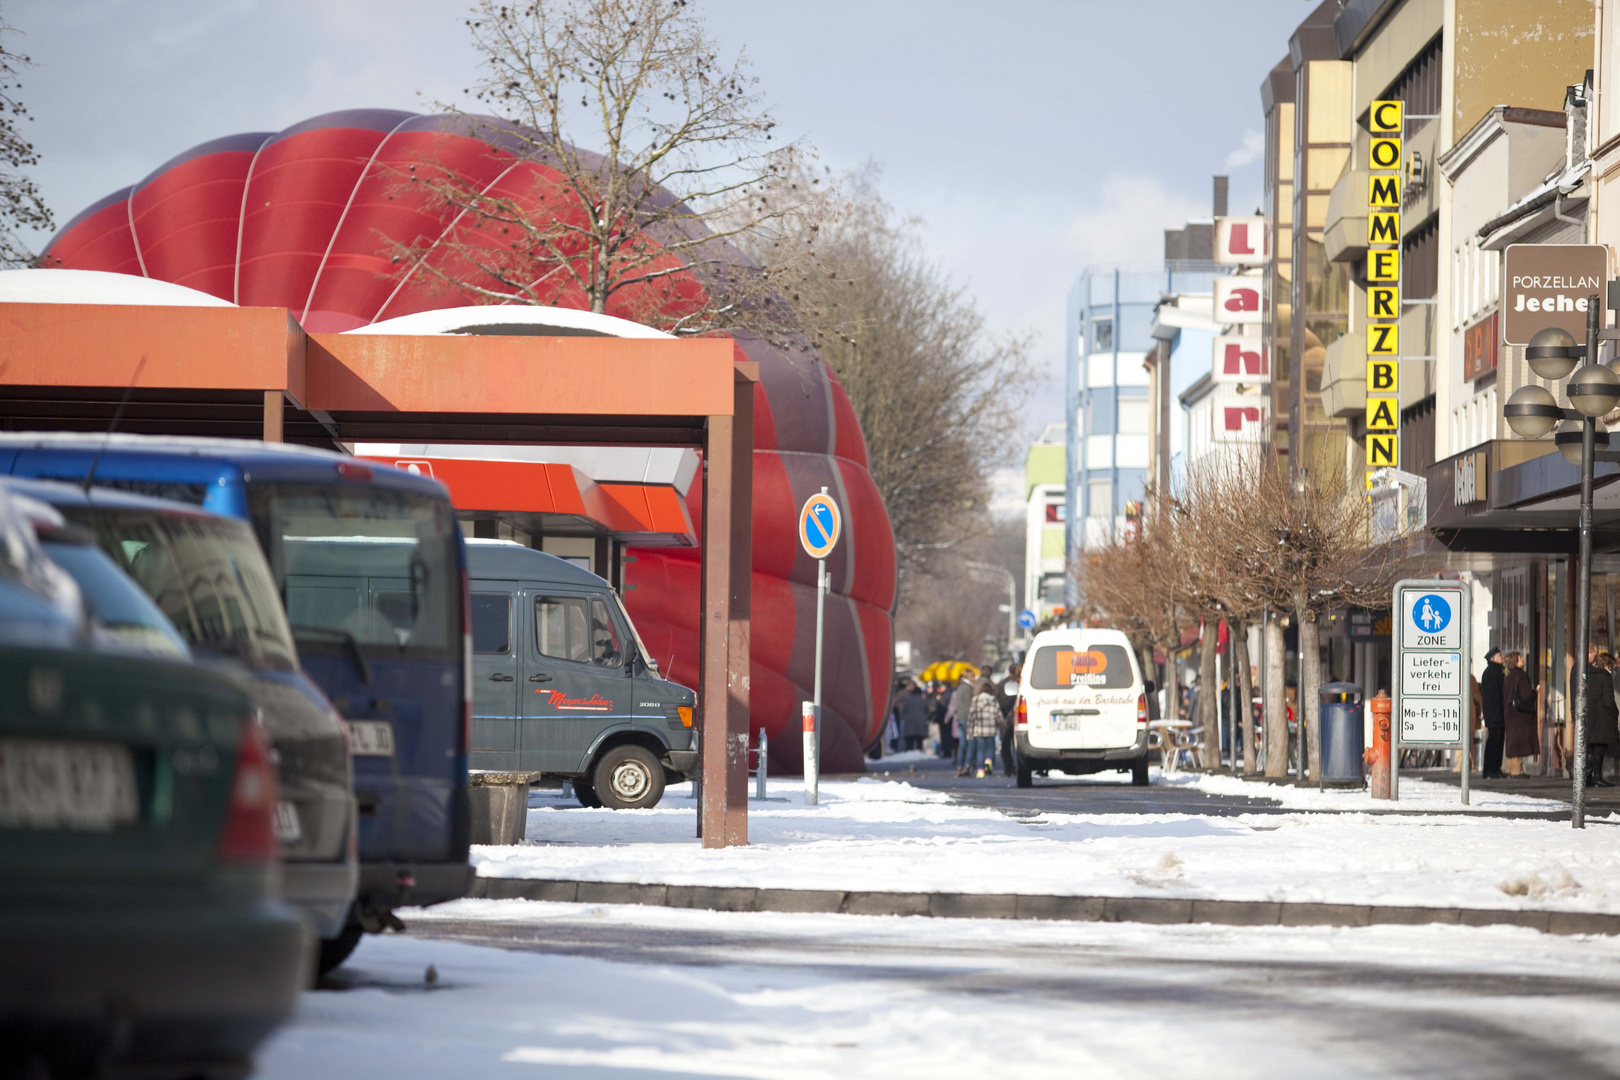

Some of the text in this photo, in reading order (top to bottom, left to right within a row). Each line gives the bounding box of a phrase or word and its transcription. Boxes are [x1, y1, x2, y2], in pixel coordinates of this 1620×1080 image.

[1369, 103, 1400, 464] COMMERZBAN
[1512, 275, 1600, 289] PORZELLAN
[1513, 293, 1589, 313] Jeche
[1417, 635, 1447, 646] ZONE
[1412, 657, 1450, 667] Liefer-
[1410, 669, 1453, 679] verkehr
[1422, 681, 1441, 691] frei
[547, 690, 582, 710] Meyer
[1063, 697, 1076, 705] aus
[1079, 694, 1091, 705] der
[1095, 693, 1134, 705] Backstube
[1404, 708, 1458, 718] Mo-Fr 5-11 h
[1404, 721, 1458, 731] Sa 5-10 h
